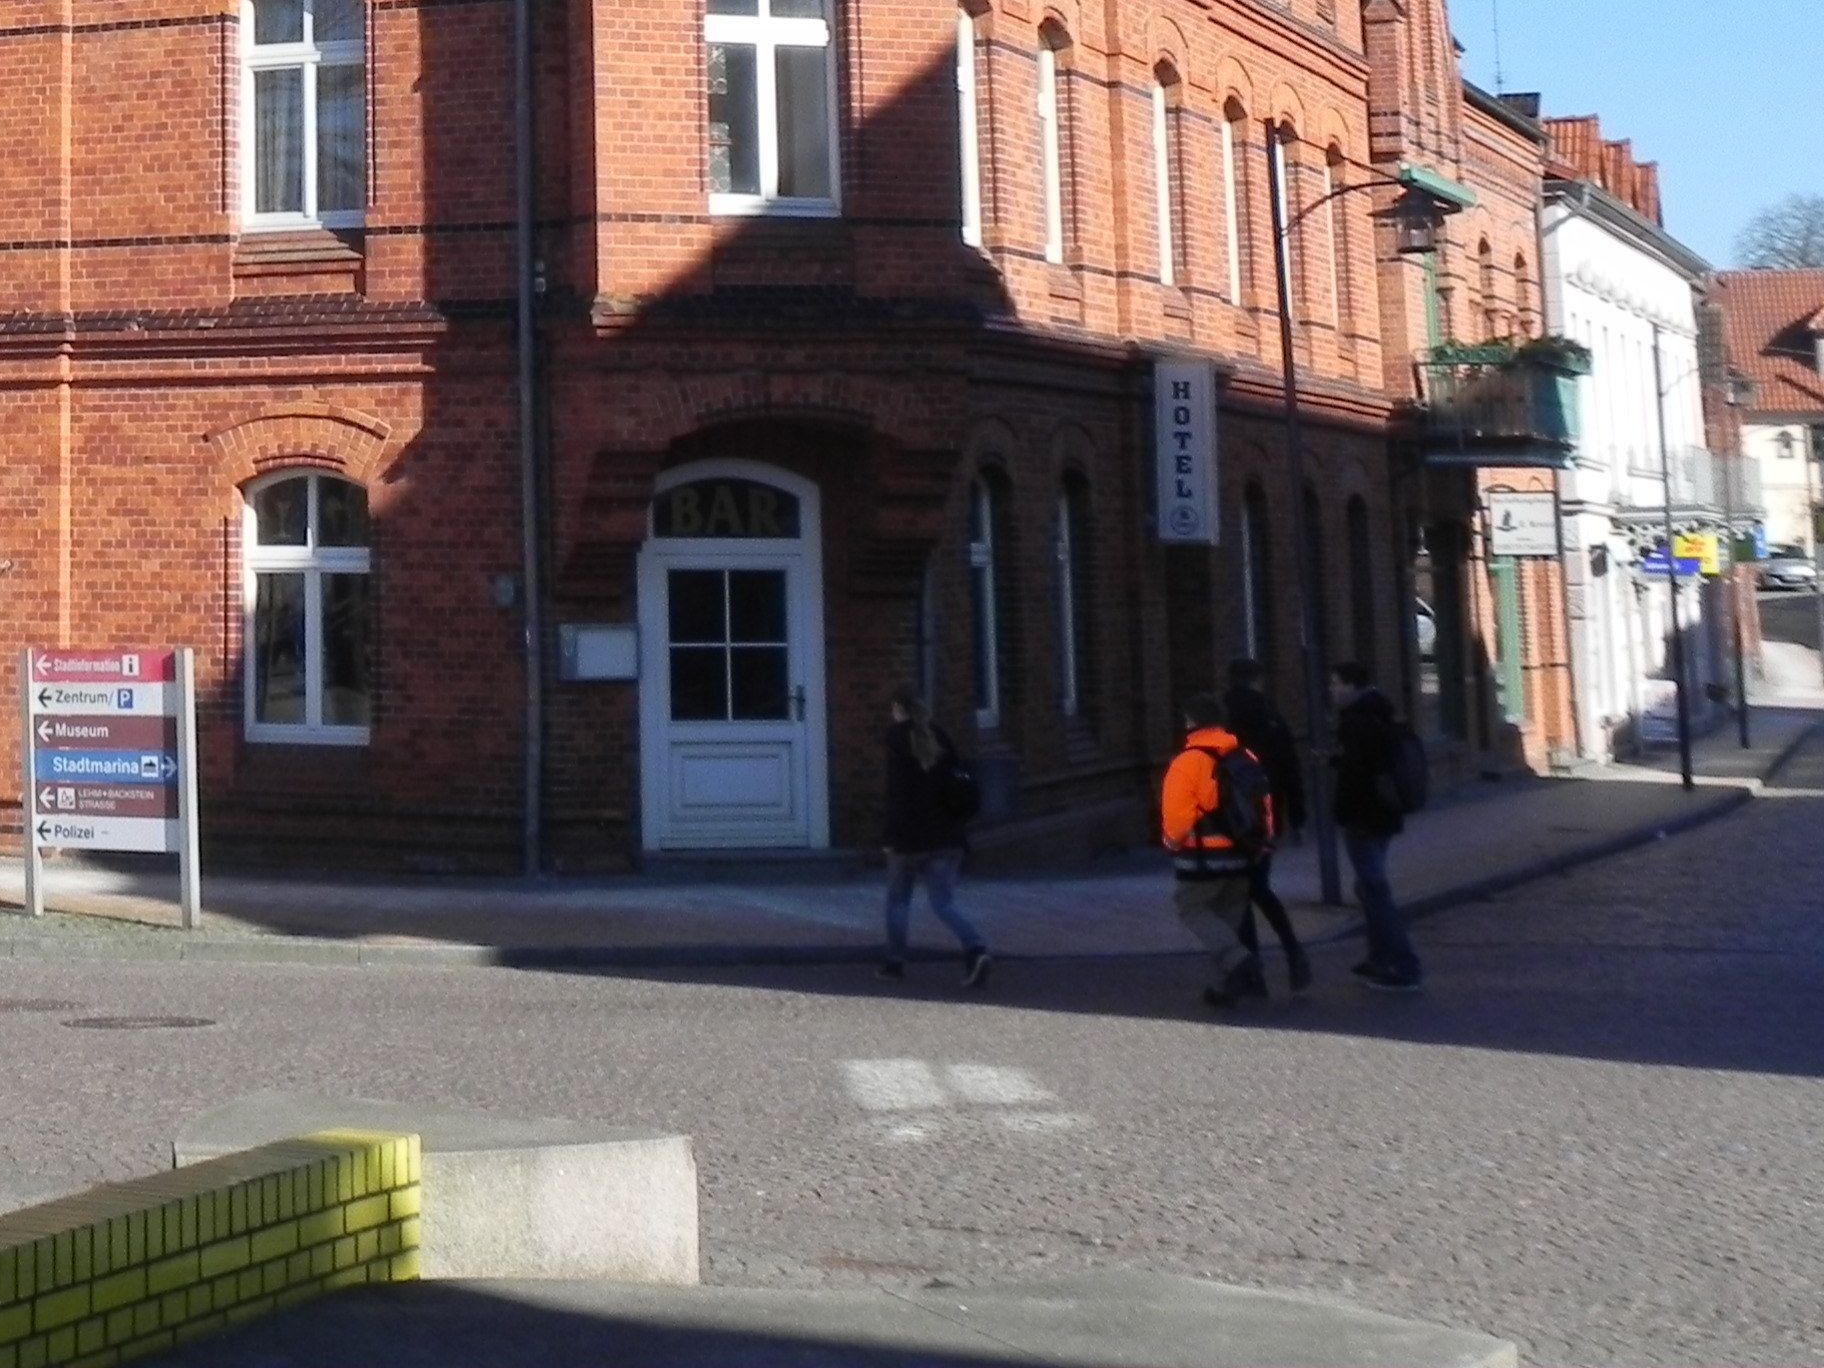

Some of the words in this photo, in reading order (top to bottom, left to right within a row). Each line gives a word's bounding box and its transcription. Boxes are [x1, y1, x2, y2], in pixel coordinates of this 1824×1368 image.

[1172, 380, 1193, 499] HOTEL
[671, 485, 783, 535] BAR
[53, 658, 120, 673] Stadtinformation
[55, 722, 110, 738] Museum
[52, 756, 140, 774] Stadtmarina
[54, 824, 95, 839] Polizei
